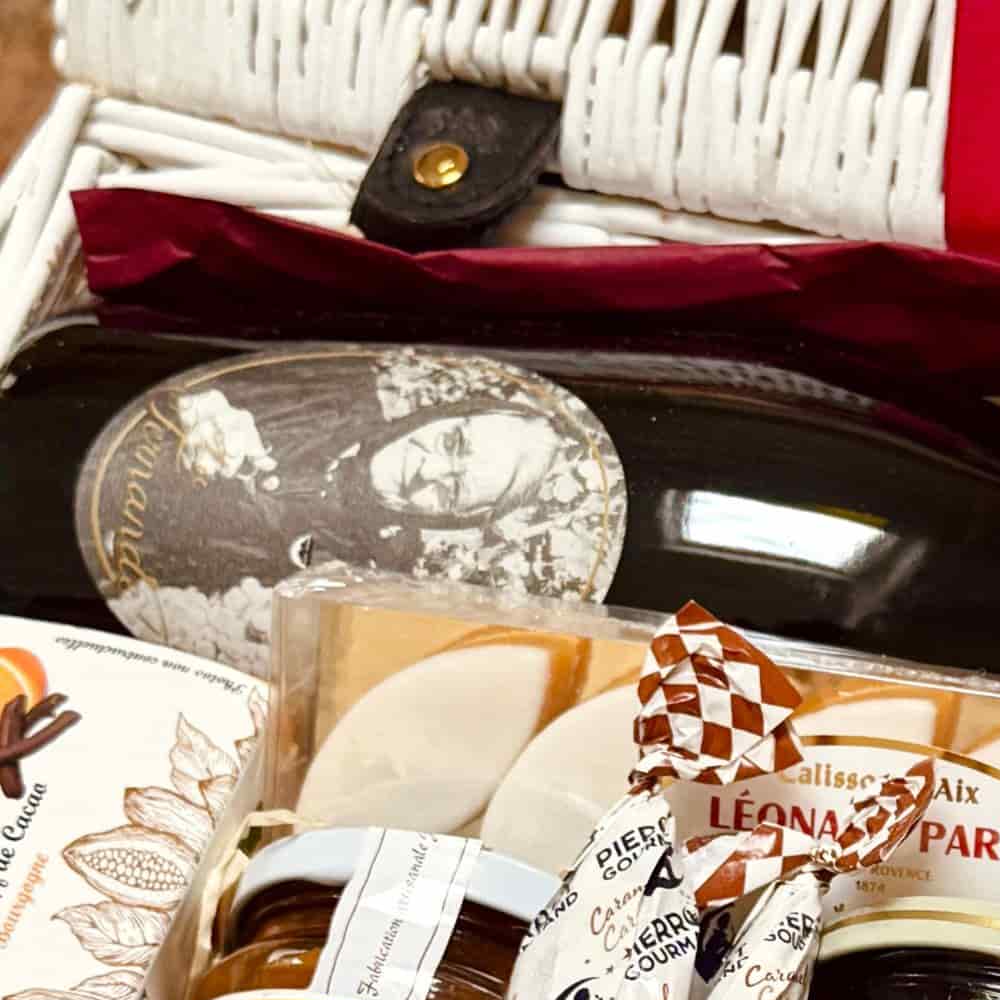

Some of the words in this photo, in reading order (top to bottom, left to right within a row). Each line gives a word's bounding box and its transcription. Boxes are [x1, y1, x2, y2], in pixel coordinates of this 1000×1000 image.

[162, 659, 190, 673] non
[934, 776, 981, 806] Aix
[1, 782, 48, 842] Cacao
[869, 864, 932, 881] ROVENCE
[356, 917, 404, 998] Fabrication
